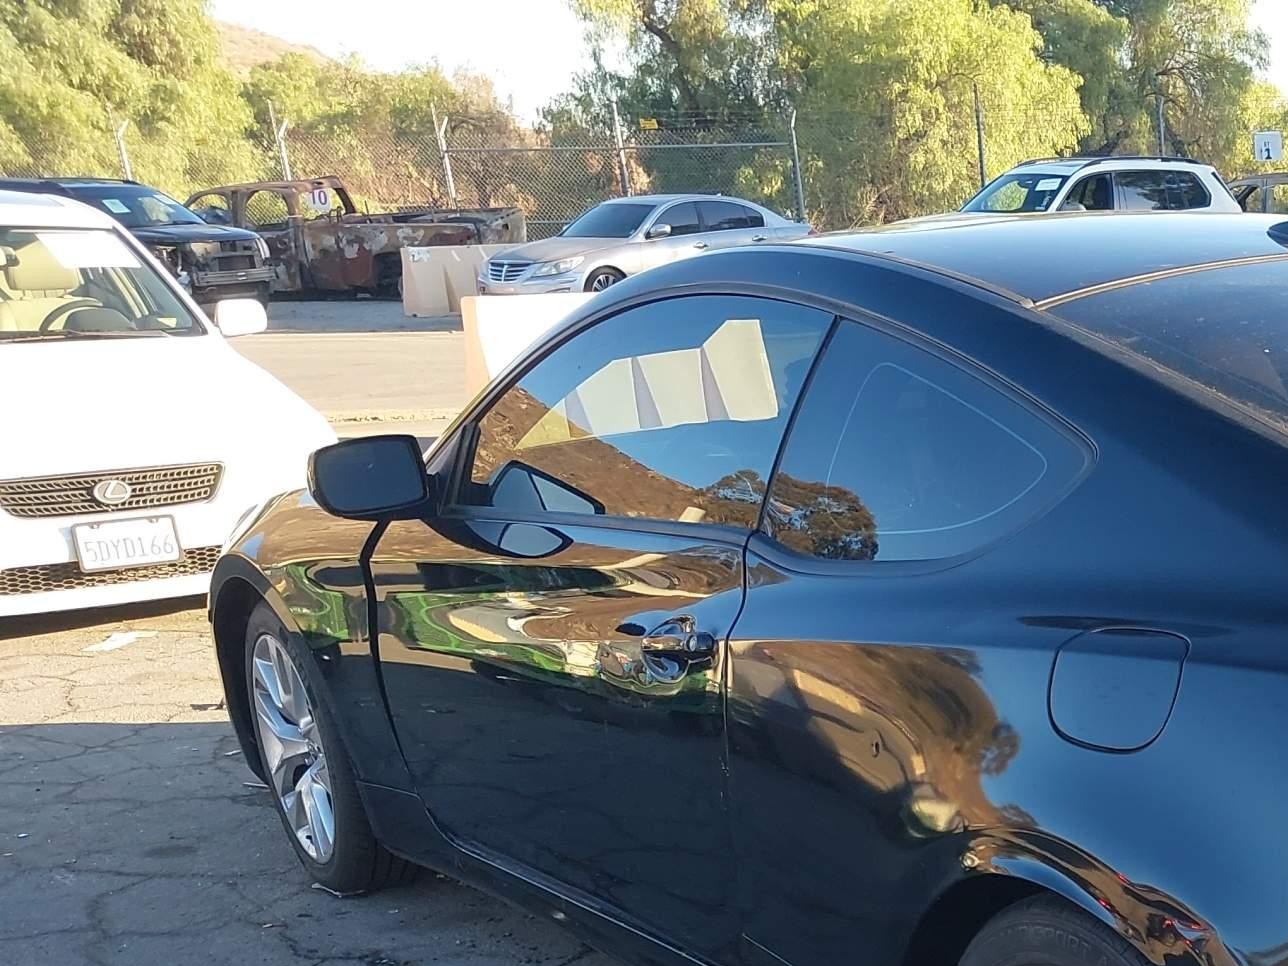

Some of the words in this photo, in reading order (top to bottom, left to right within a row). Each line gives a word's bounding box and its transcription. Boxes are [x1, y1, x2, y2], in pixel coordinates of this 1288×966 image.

[1264, 148, 1272, 160] 1
[310, 190, 327, 205] 10
[84, 535, 174, 562] 5DYD166
